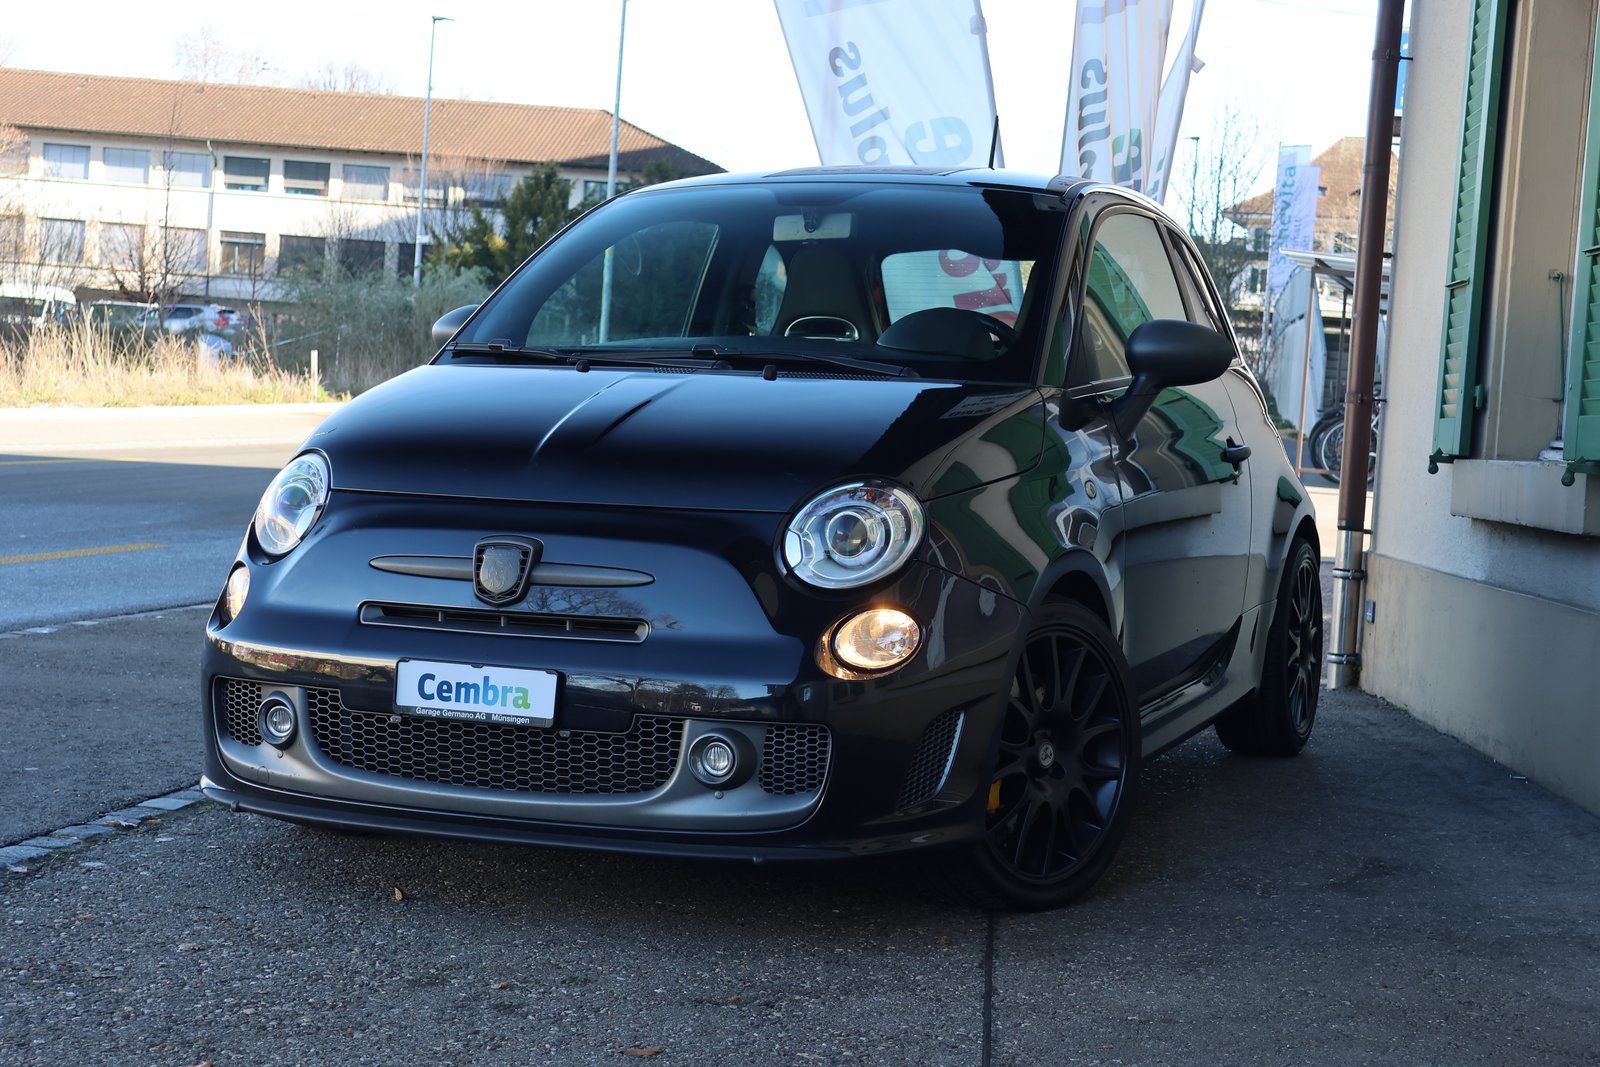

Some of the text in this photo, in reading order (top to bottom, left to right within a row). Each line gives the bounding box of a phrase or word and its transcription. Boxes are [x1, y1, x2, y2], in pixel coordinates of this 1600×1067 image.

[417, 672, 532, 710] Cembra
[415, 707, 530, 725] Garage Germano AG Münsingen
